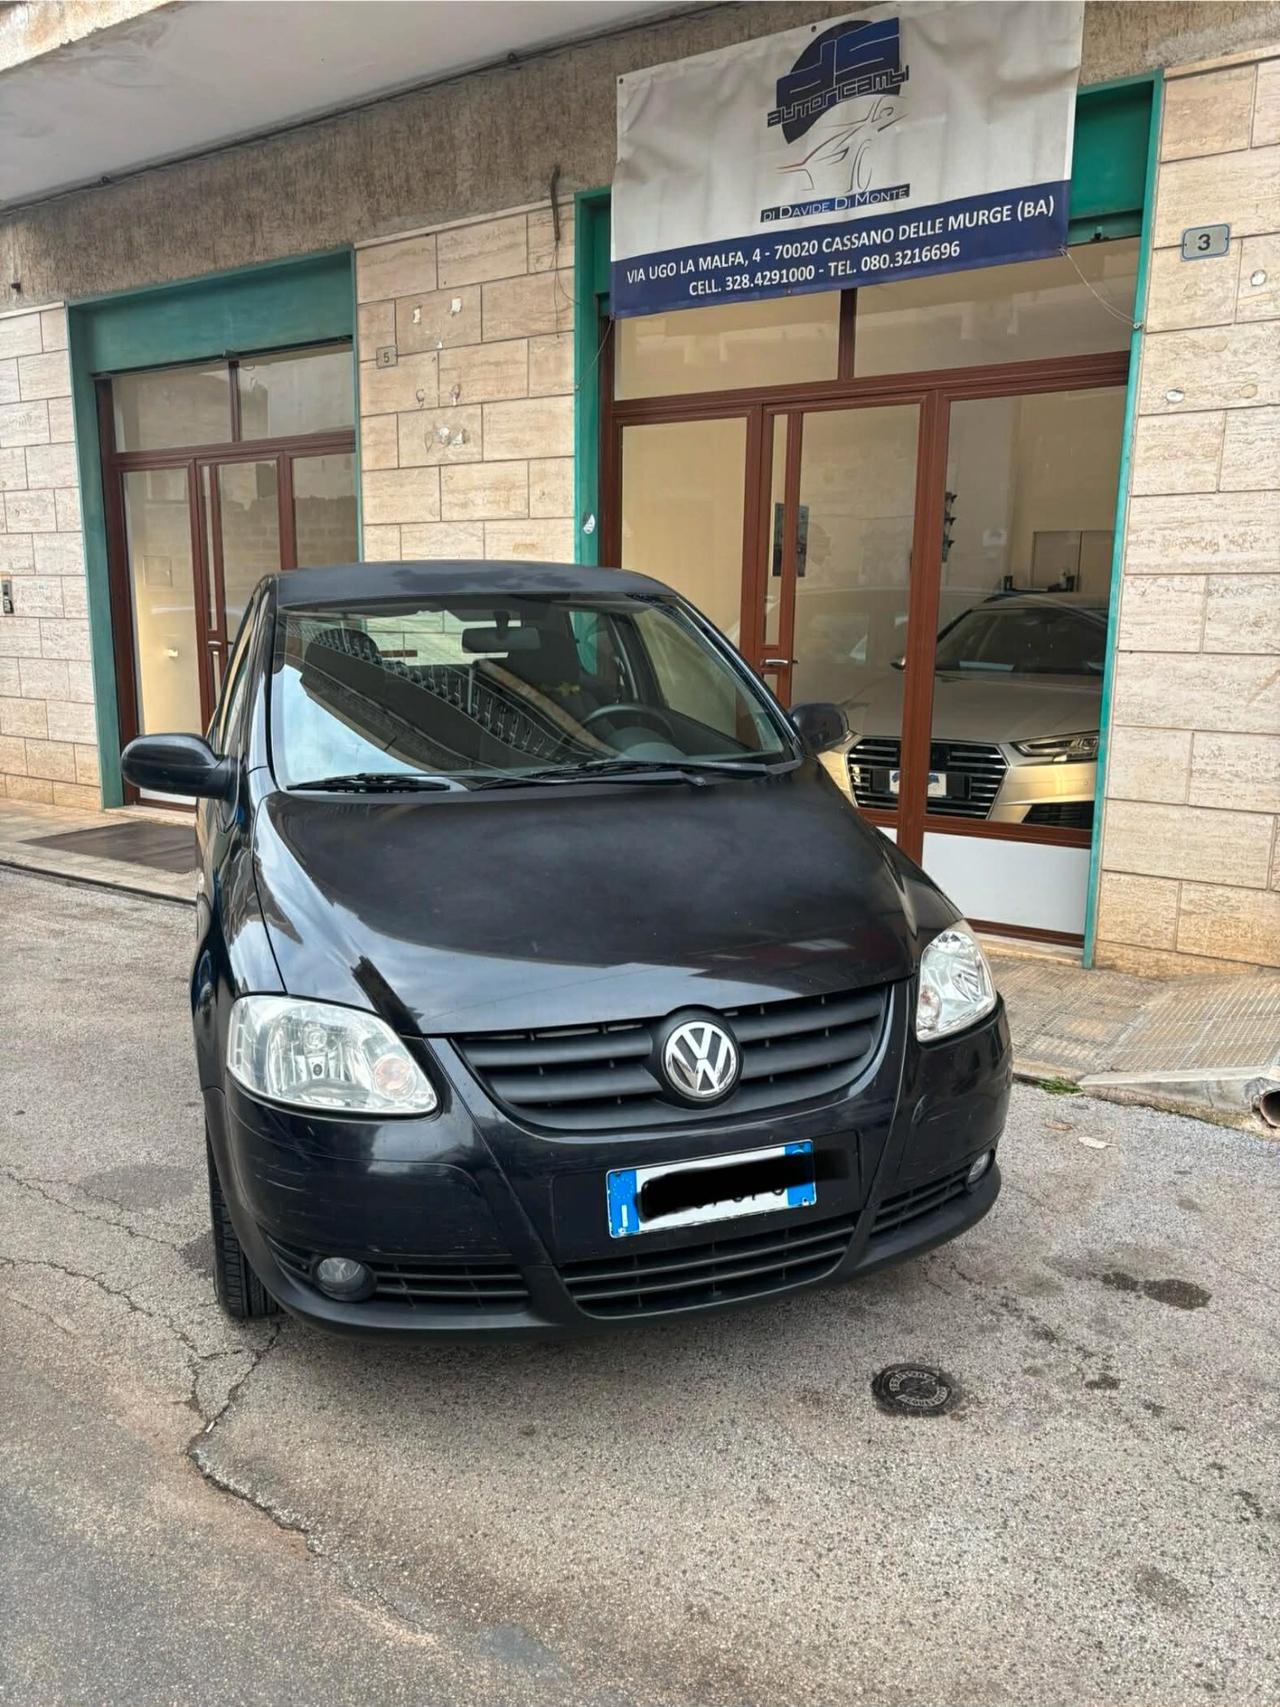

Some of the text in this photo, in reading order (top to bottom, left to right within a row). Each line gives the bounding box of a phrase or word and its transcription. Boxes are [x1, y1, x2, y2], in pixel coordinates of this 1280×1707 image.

[626, 268, 646, 284] VIA
[649, 262, 677, 280] UGO
[680, 259, 695, 275] LA
[699, 251, 749, 271] MALFA,
[752, 248, 761, 263] 4
[774, 240, 818, 260] 70020
[821, 228, 894, 252] CASSANO
[899, 218, 944, 240] DELLE
[948, 205, 1012, 231] MURGE
[1017, 195, 1054, 222] (BA)
[1198, 233, 1211, 251] 3
[689, 279, 722, 296] CELL.
[725, 266, 815, 291] 328.4291000
[828, 258, 857, 278] TEL.
[860, 241, 960, 273] 080.3216696
[383, 352, 390, 364] 5
